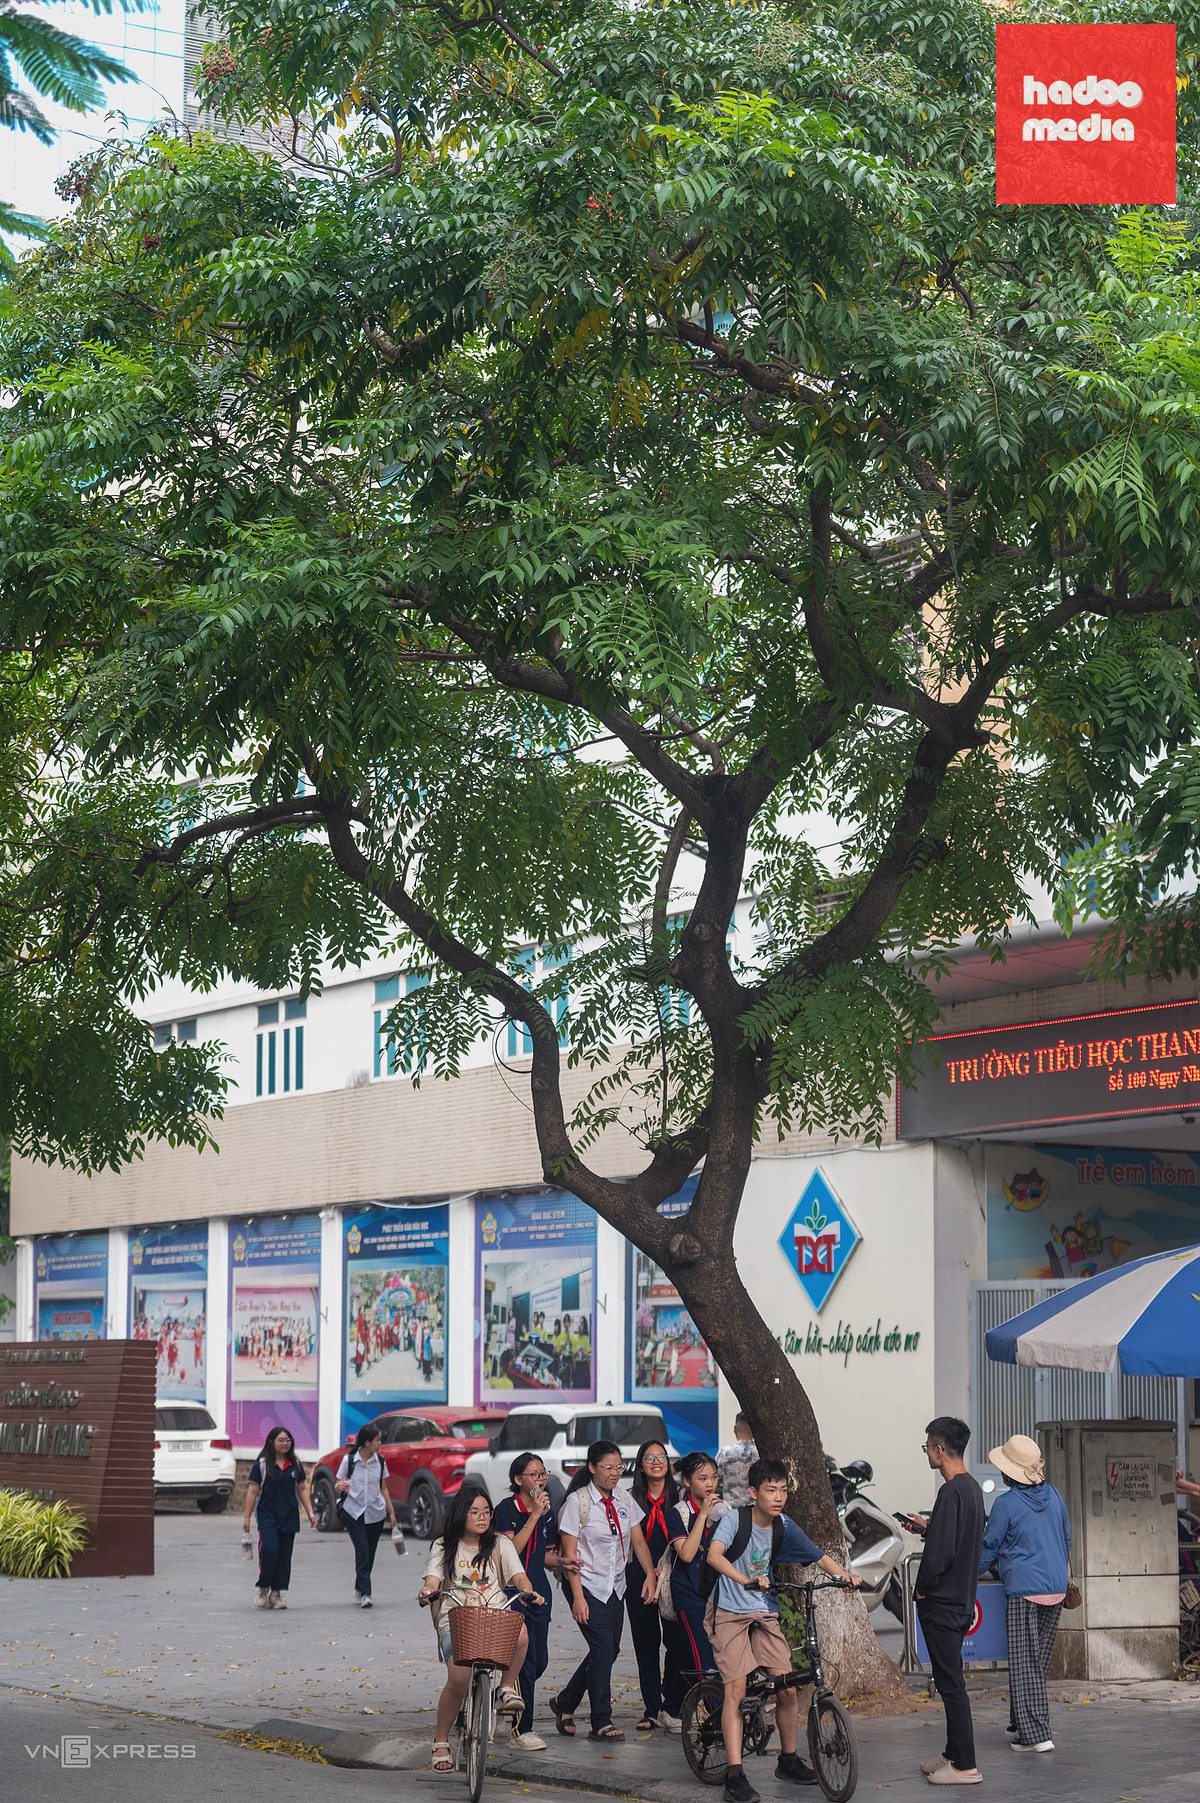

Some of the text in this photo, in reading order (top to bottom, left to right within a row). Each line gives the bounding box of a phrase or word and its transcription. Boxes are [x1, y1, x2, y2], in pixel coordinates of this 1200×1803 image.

[946, 1048, 1030, 1083] TRƯỜNG
[1034, 1039, 1083, 1075] TIỂU
[1086, 1036, 1133, 1072] HỌC
[1108, 1068, 1124, 1092] Số
[1126, 1071, 1147, 1090] 100
[1076, 1154, 1196, 1186] Trẻ em hôm
[784, 1328, 802, 1355] tâm
[856, 1318, 881, 1355] cánh
